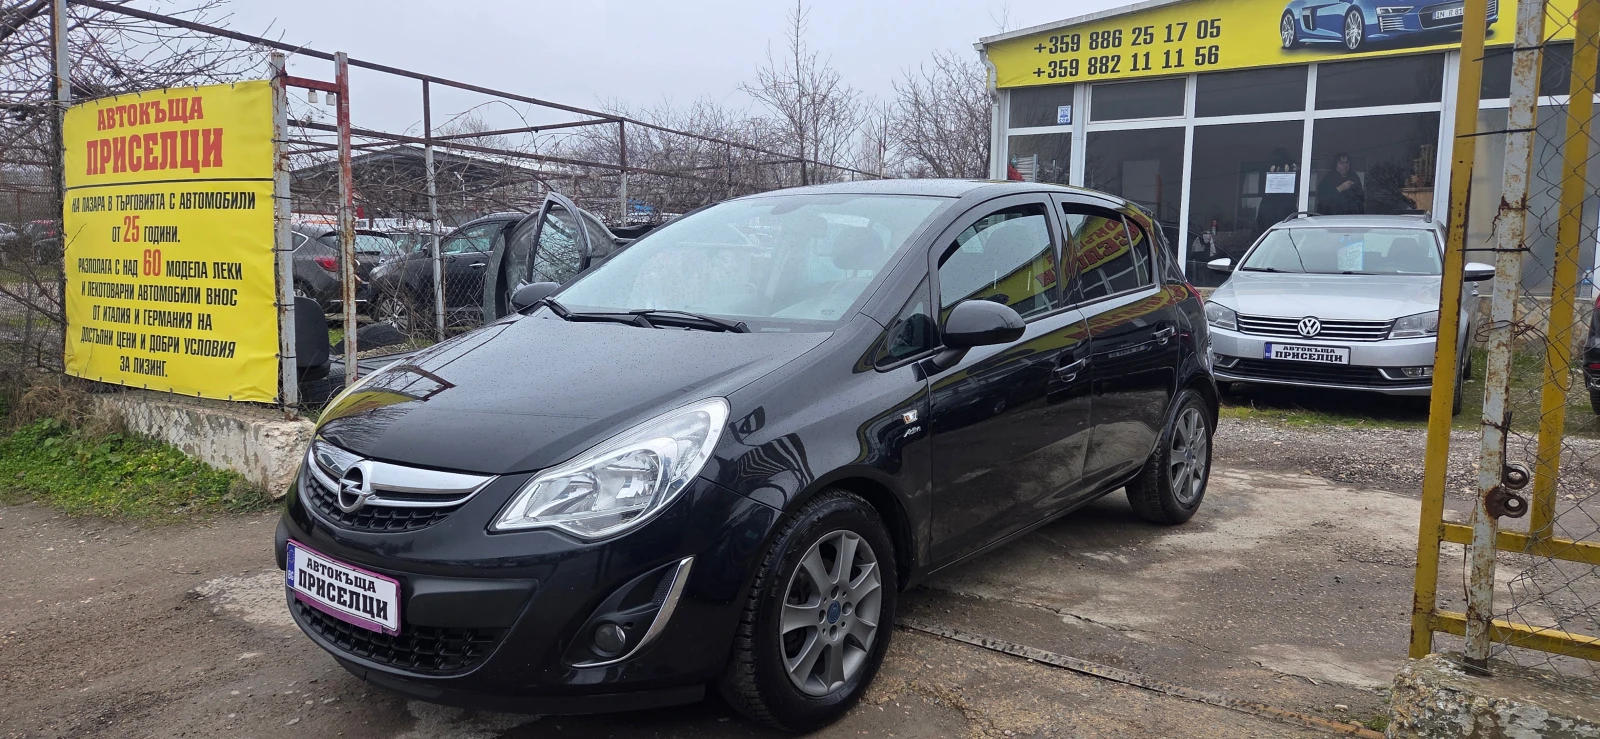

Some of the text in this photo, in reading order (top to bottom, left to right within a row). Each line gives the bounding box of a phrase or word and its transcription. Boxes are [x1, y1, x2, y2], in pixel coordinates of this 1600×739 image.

[1034, 18, 1221, 54] +359 886 25 17 05
[1032, 45, 1219, 79] +359 882 11 11 56
[97, 96, 204, 131] АВТОКЪЩА
[86, 128, 224, 176] ПРИСЕЛЦИ
[72, 192, 256, 213] НА ПАЗАРА В ТЪРГОВИЯТА С АВТОМОБИЛИ
[112, 215, 180, 245] ОТ 25 ГОДИНИ.
[78, 249, 243, 280] РАЗПОЛАГА С НАД 60 МОДЕЛА ЛЕКИ
[82, 281, 238, 307] И ЛЕКОТОВАРНИ АВТОМОБИЛИ ВНОС
[92, 306, 212, 331] ОТ ИТАЛИЯ И ГЕРМАНИЯ НА
[80, 327, 236, 359] ДОСТЪПНИ ЦЕНИ И ДОБРИ УСЛОВИЯ
[1275, 351, 1343, 362] ПРИСЕЛЦИ
[1282, 345, 1335, 354] АВТОКЪЩА
[120, 356, 168, 377] ЗА ЛИЗИНГ.
[307, 558, 376, 593] АВТОКЪЩА
[299, 568, 388, 621] ПРИСЕЛЦИ
